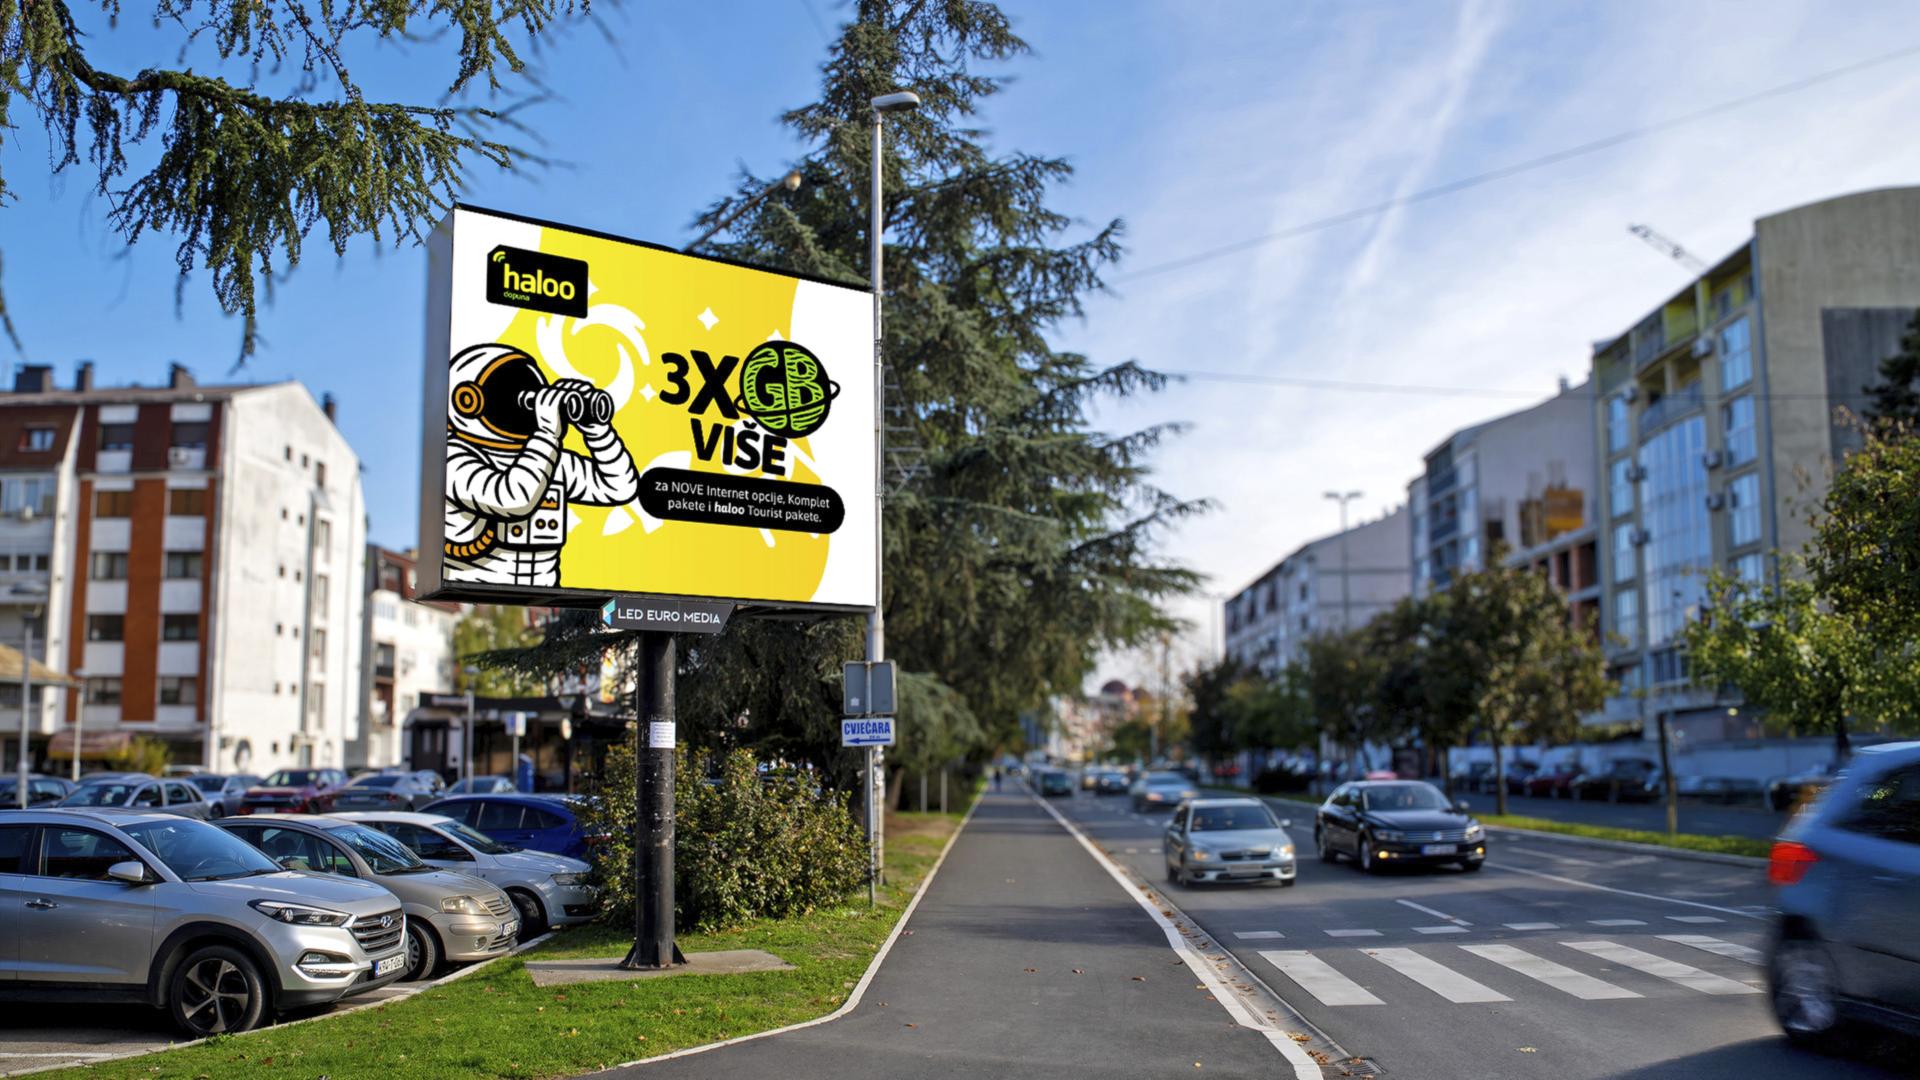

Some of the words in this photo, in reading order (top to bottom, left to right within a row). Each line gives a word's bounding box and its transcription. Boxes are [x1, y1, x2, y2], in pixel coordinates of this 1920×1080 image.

[503, 263, 576, 301] haloo
[503, 291, 530, 302] dopuna
[690, 418, 788, 476] VIŠE
[655, 481, 669, 492] za
[671, 482, 704, 496] NOVE
[706, 485, 750, 501] Internet
[787, 494, 830, 509] Komplet
[667, 498, 706, 512] pakete
[714, 501, 746, 516] haloo
[747, 505, 783, 519] Tourist
[785, 509, 822, 523] pakete.
[617, 607, 644, 620] LED
[646, 609, 681, 622] EURO
[683, 611, 721, 624] MEDIA
